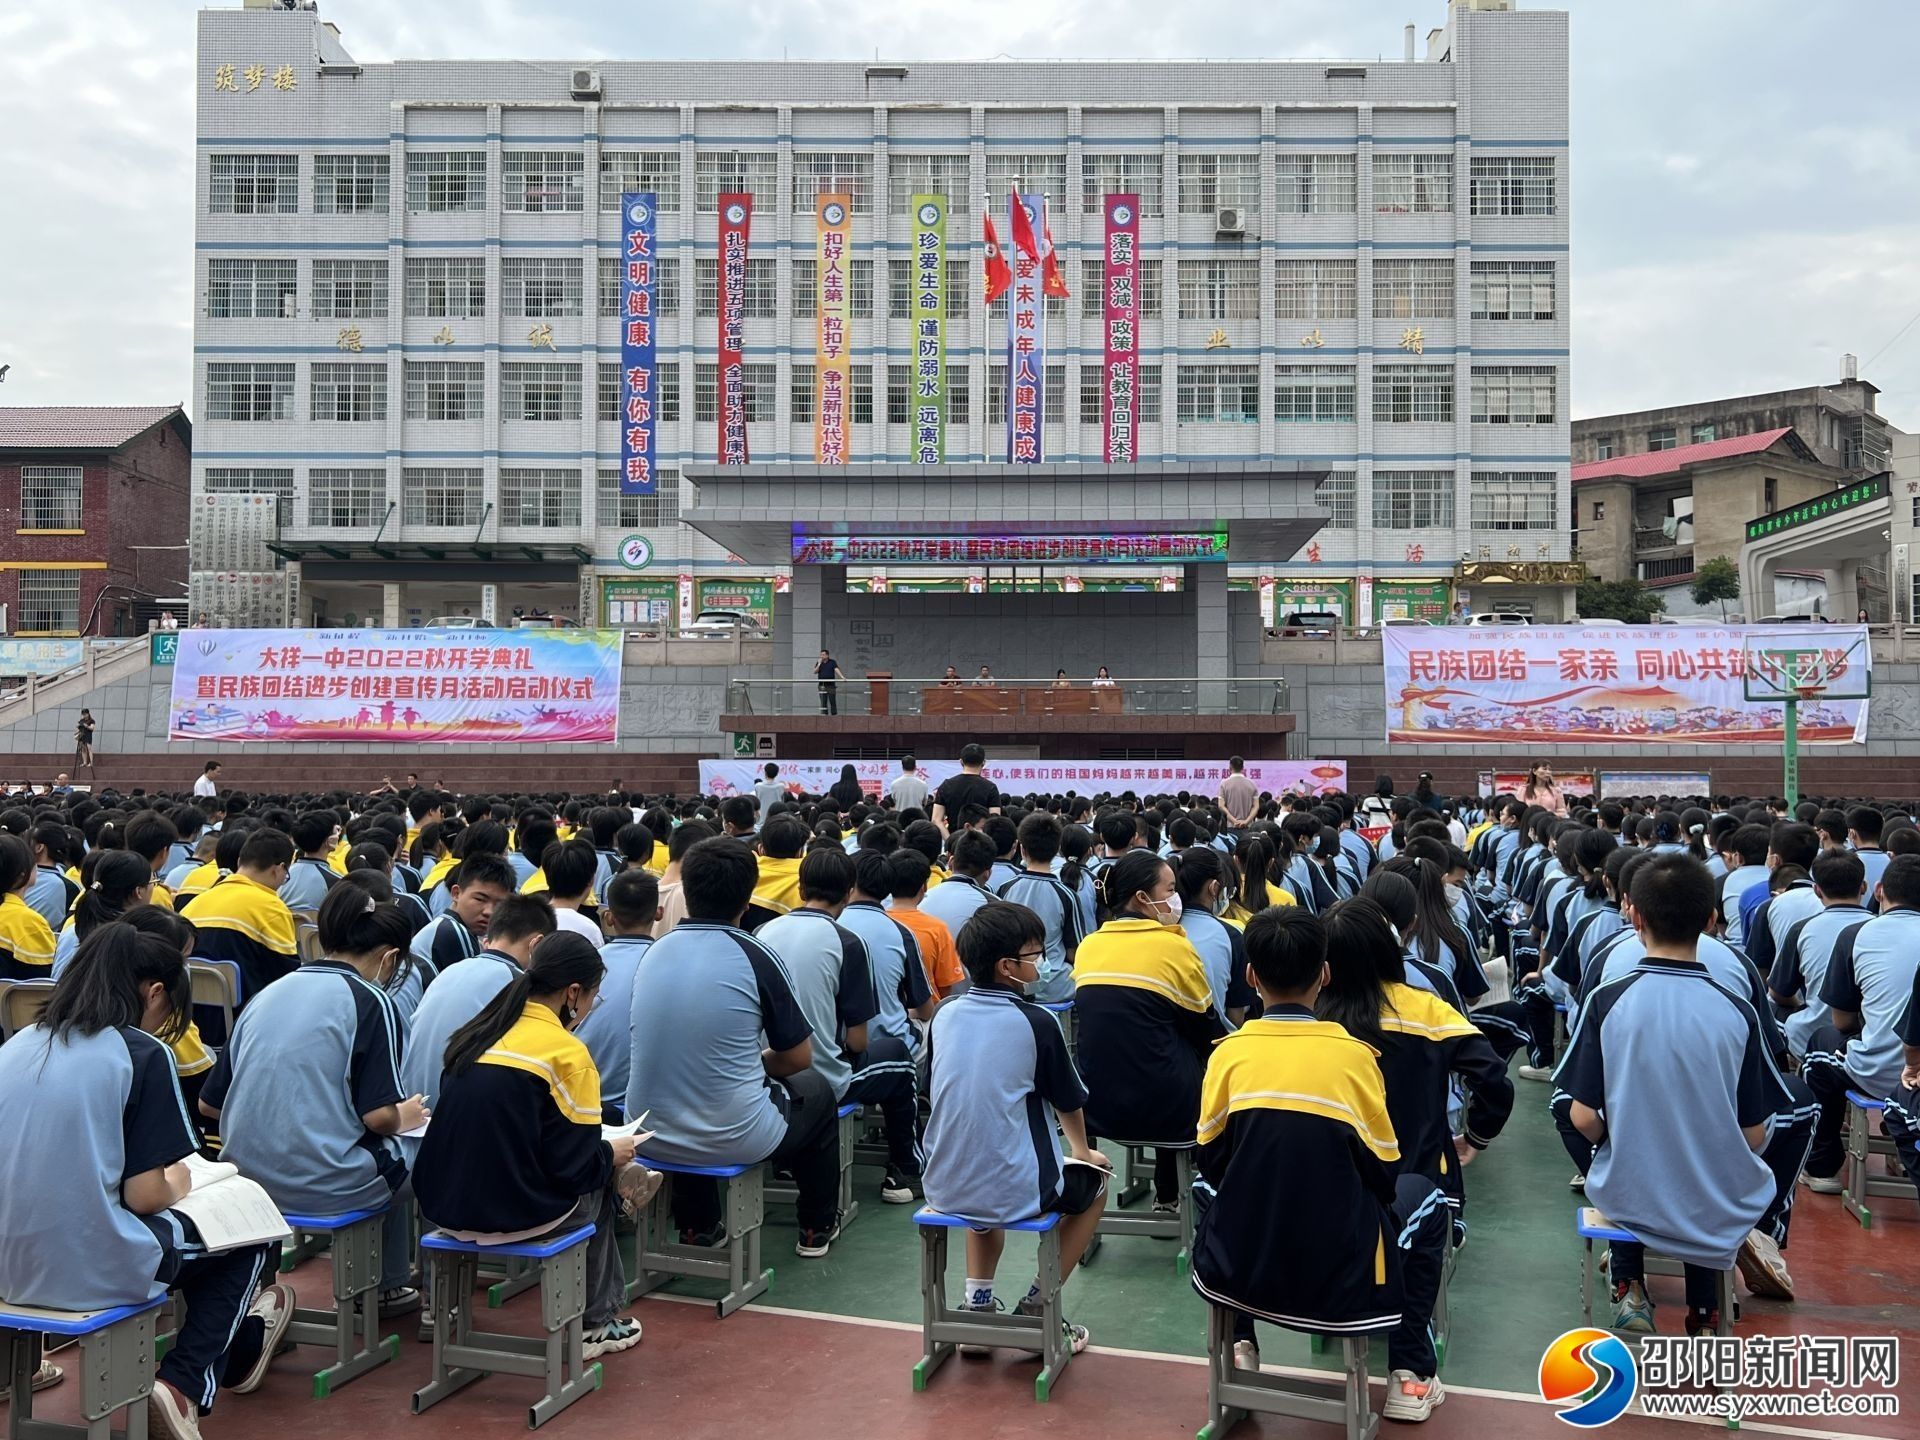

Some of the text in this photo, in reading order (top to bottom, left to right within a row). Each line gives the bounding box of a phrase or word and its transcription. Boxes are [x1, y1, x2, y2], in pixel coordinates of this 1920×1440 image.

[214, 62, 298, 94] 筑梦楼
[725, 231, 746, 351] 扎实推进五项管理
[822, 231, 844, 360] 扣好人生第一粒扣子
[918, 231, 940, 311] 珍爱生命
[626, 230, 651, 484] 文明健康 有你有我
[918, 318, 940, 398] 谨防溺水
[1015, 248, 1036, 464] 爱未成年人健康成
[196, 675, 594, 701] 暨民族团结进步创建宣传月活动启动仪式
[258, 646, 535, 671] 大祥一中2022秋开学典礼
[1407, 648, 1618, 682] 民族团结一家亲
